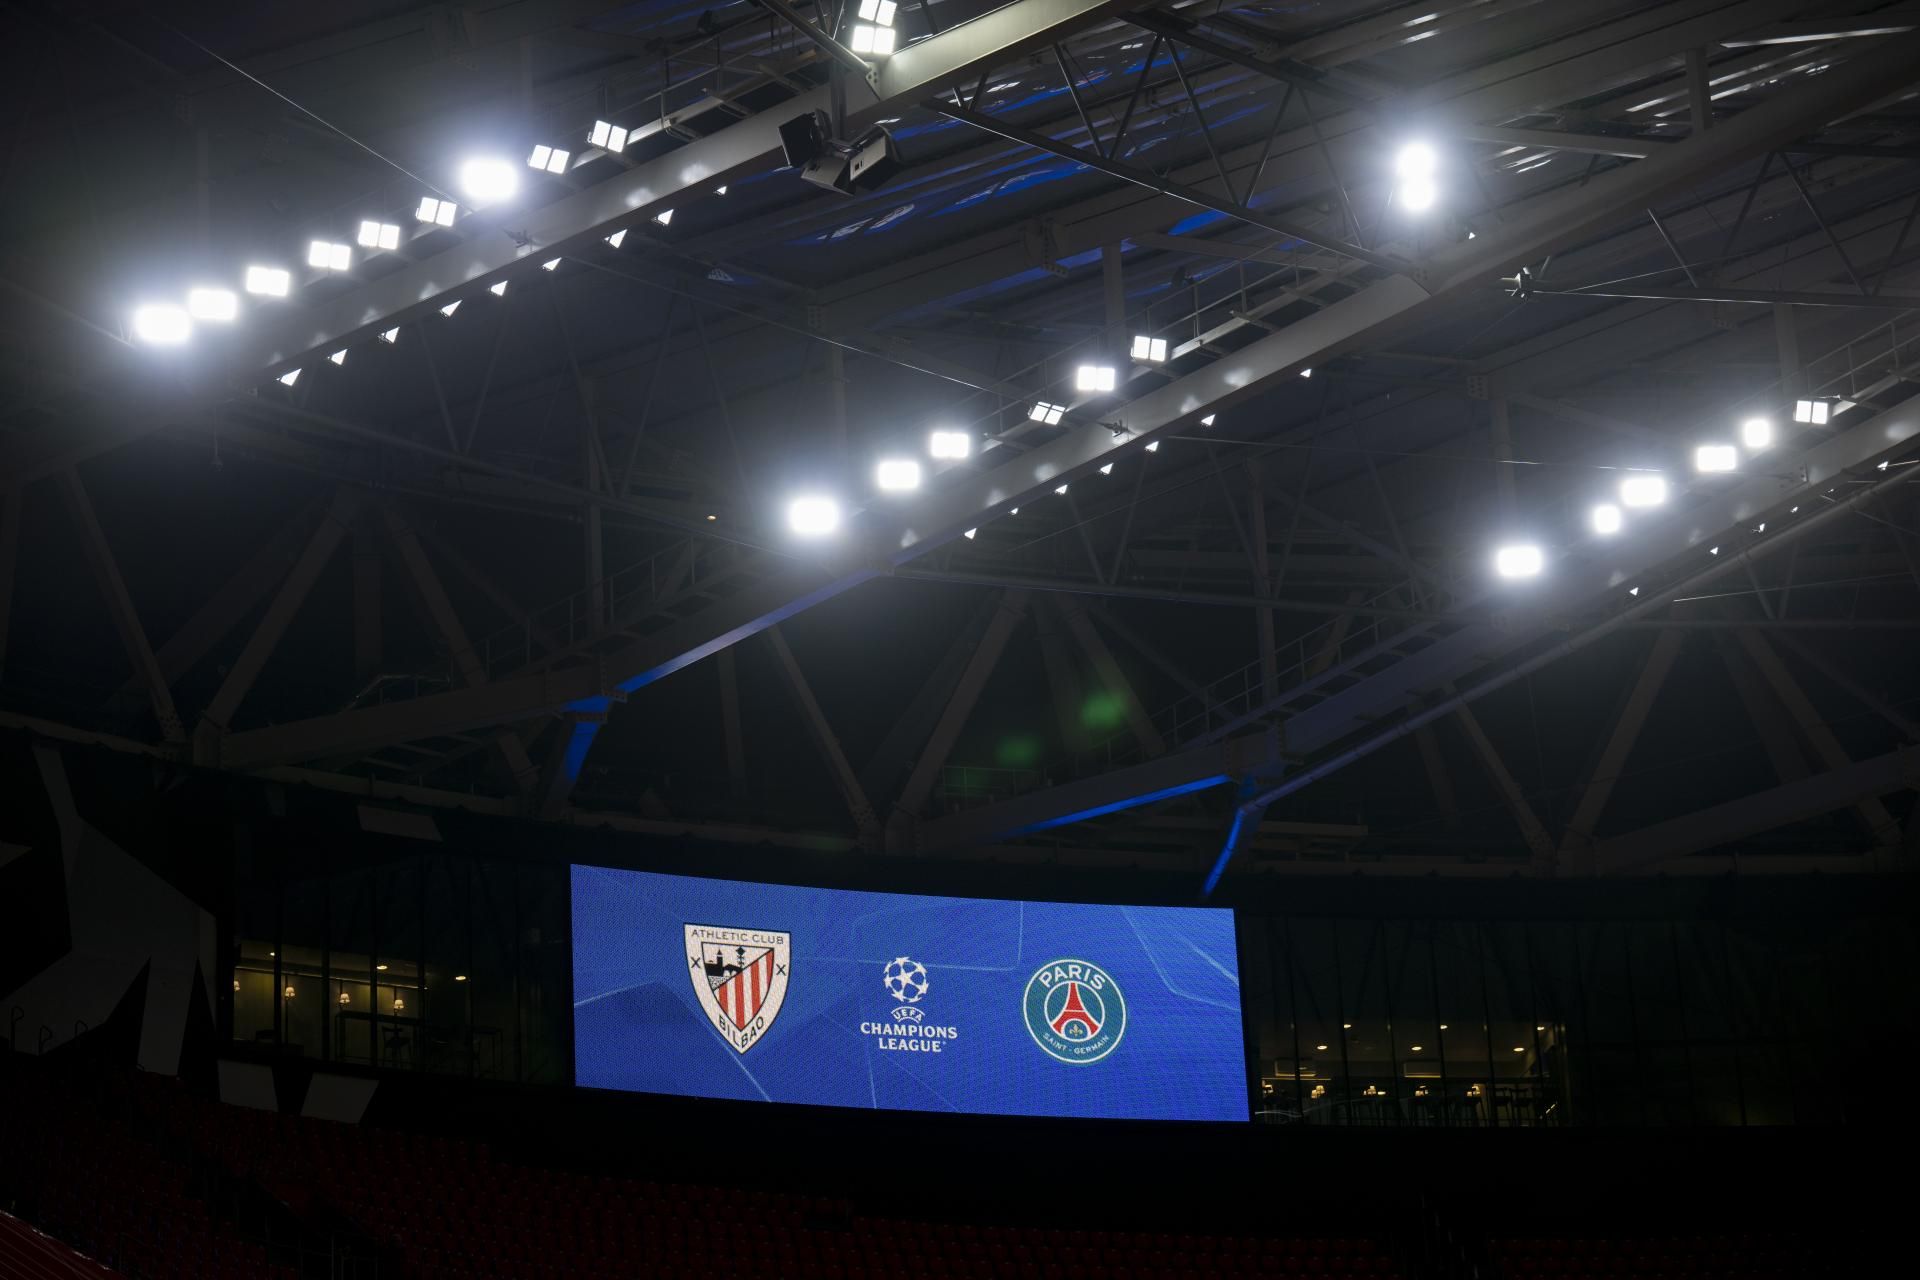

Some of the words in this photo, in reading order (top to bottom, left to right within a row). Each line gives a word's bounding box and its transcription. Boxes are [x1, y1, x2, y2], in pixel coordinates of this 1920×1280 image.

[691, 929, 749, 942] ATHLETIC
[752, 934, 784, 945] CLUB
[1038, 964, 1106, 990] PARIS
[893, 1008, 921, 1021] UEFA
[719, 1015, 764, 1048] BILBAO
[860, 1022, 958, 1039] CHAMPIONS
[878, 1037, 942, 1053] LEAGUE
[1042, 1032, 1067, 1051] SAINT
[1073, 1035, 1110, 1054] GERMAIN
